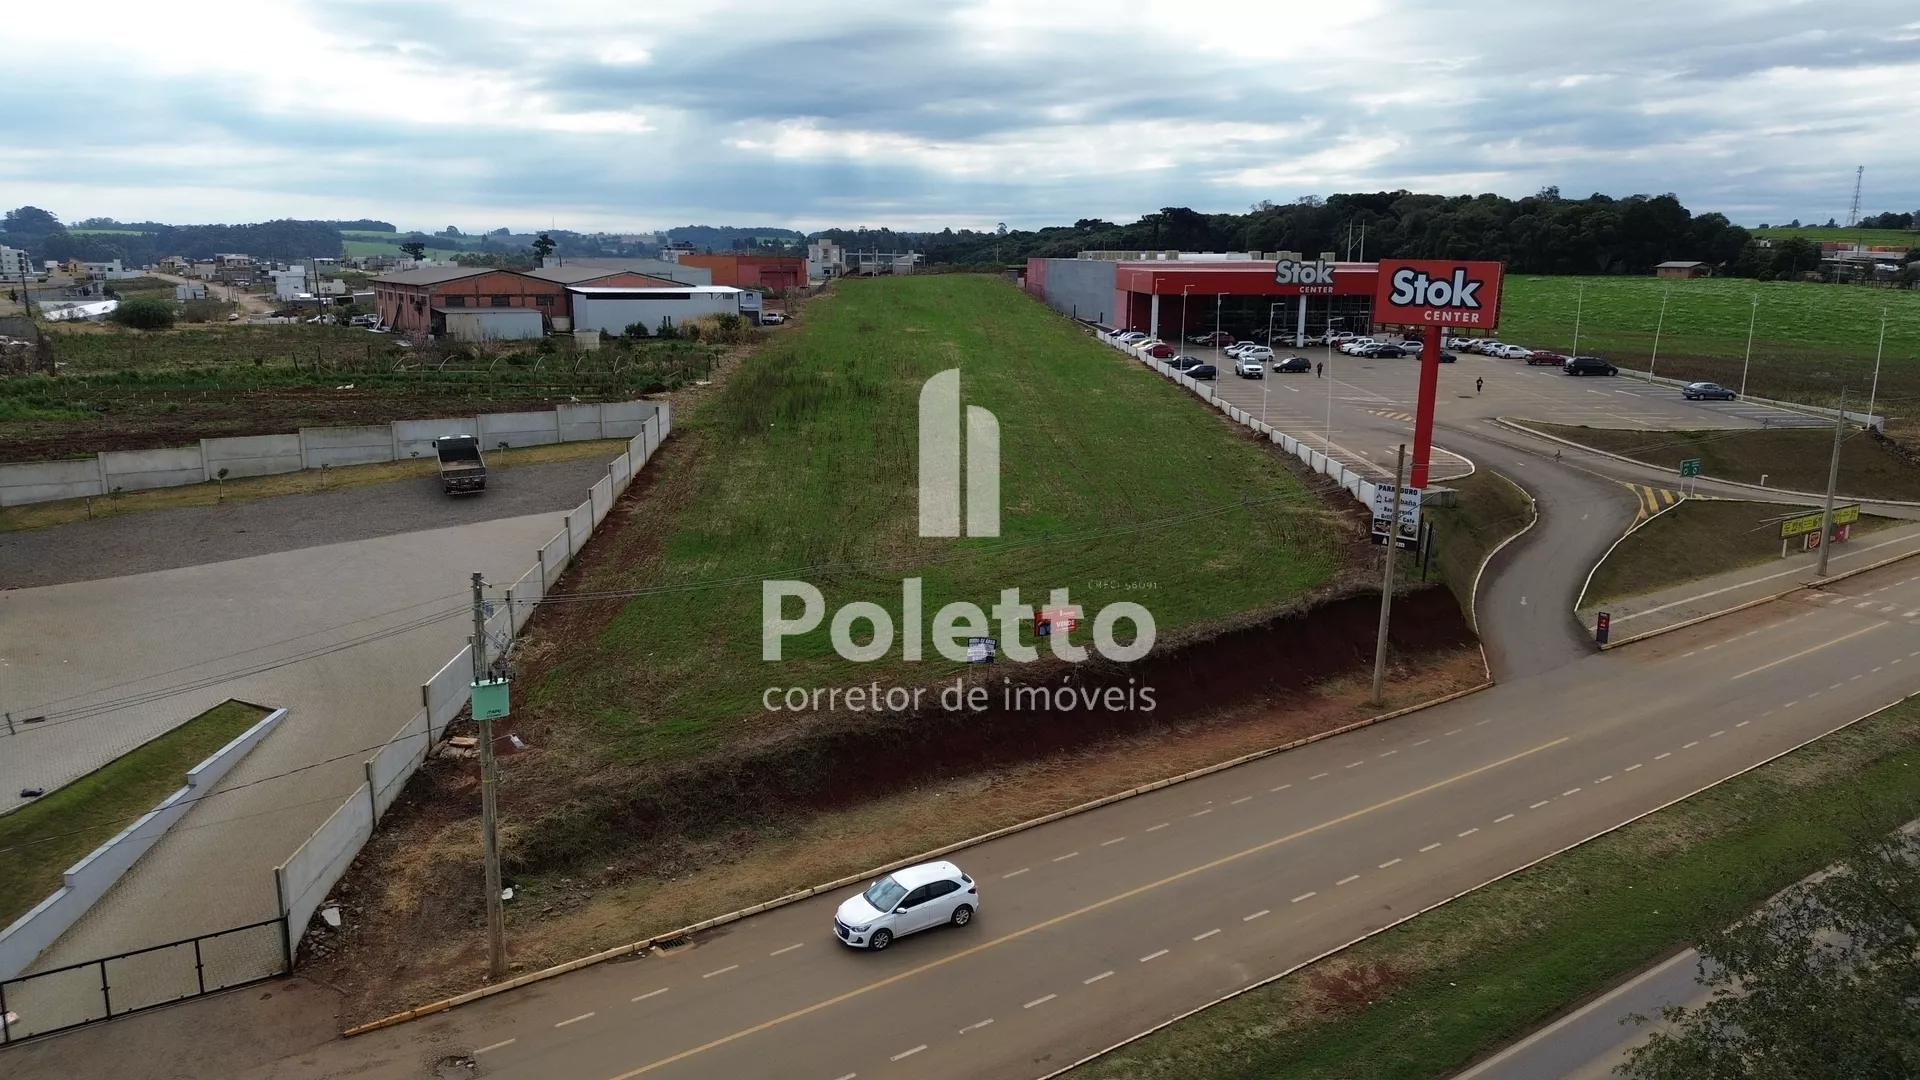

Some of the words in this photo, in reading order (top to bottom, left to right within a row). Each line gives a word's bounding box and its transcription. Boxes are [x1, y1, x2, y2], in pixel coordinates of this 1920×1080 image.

[1276, 259, 1335, 284] Stok
[1390, 268, 1482, 308] Stok
[1424, 310, 1480, 323] CENTER
